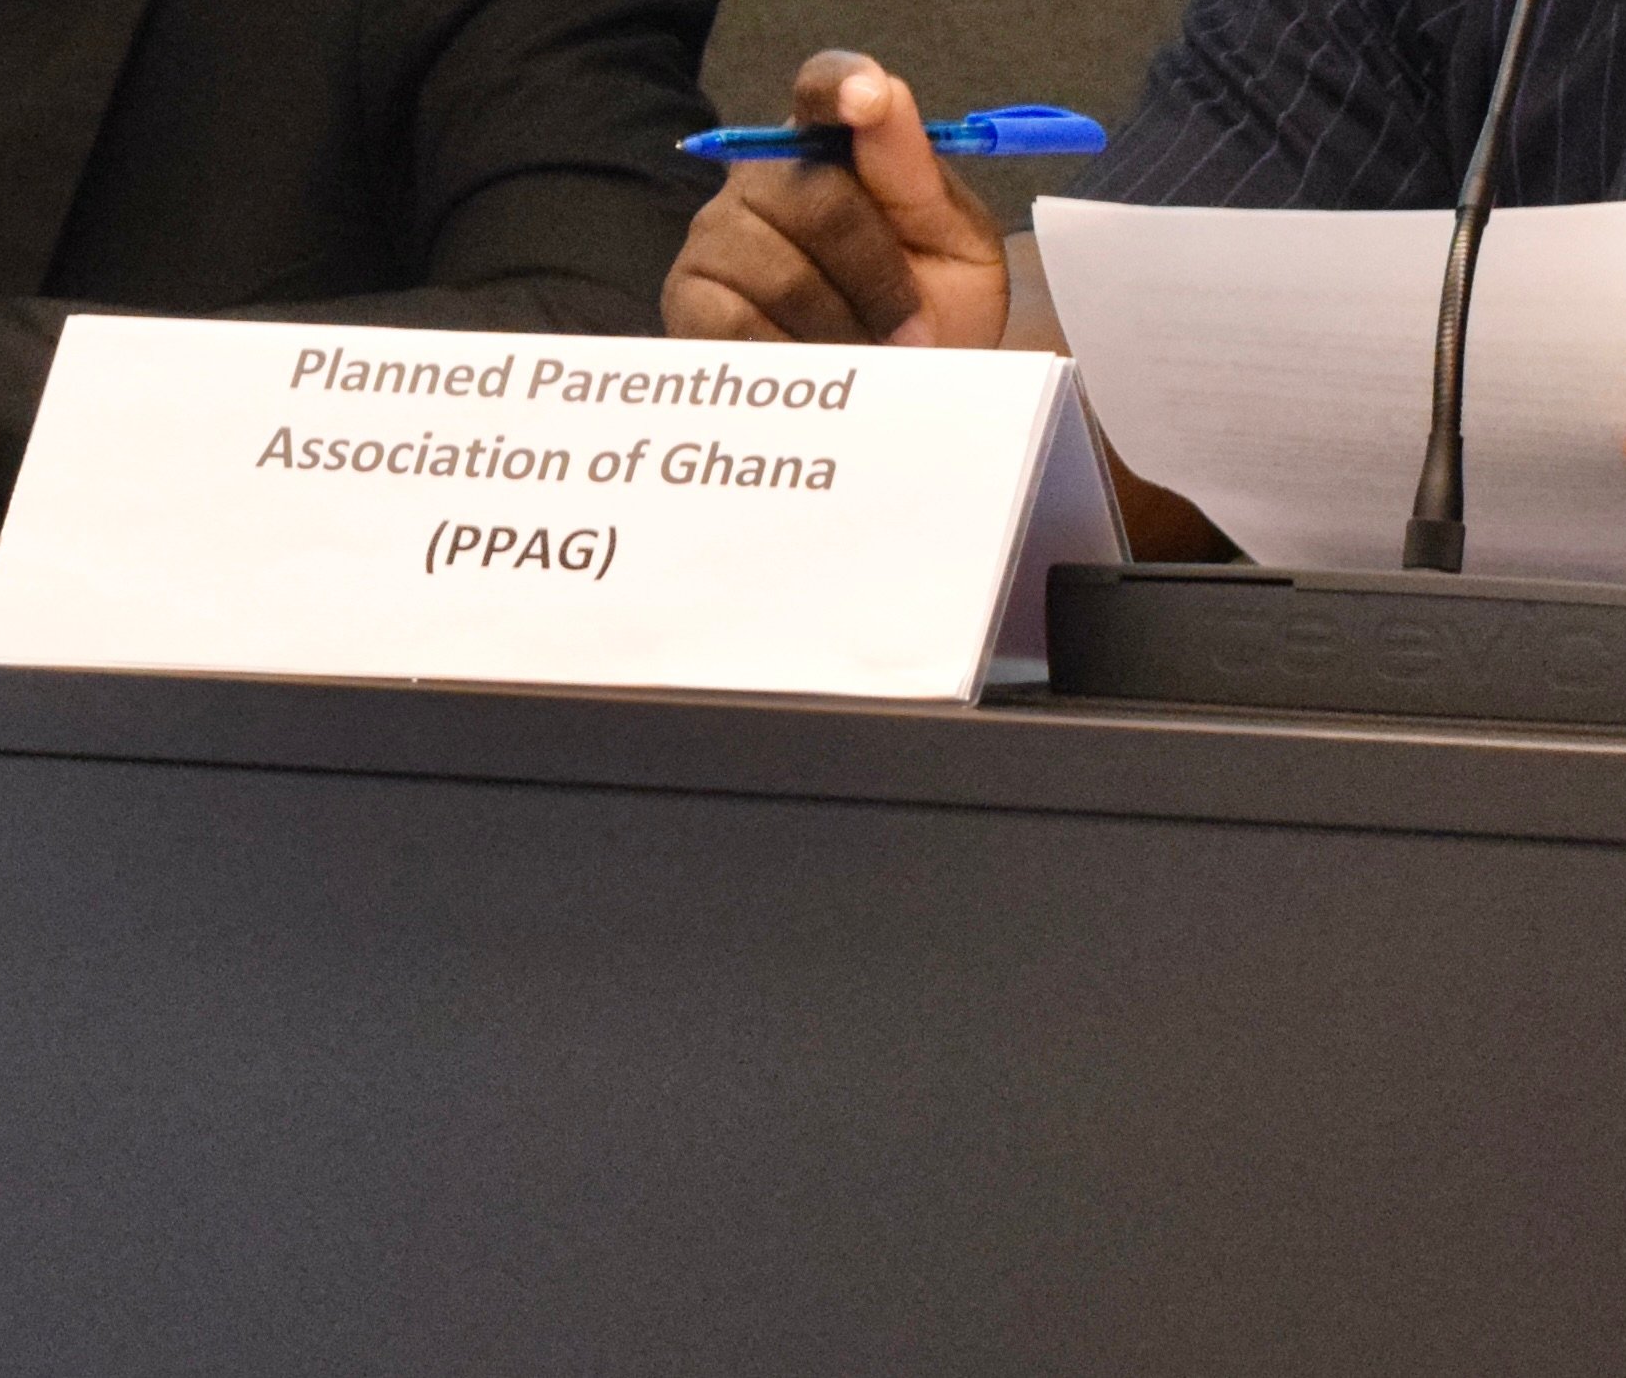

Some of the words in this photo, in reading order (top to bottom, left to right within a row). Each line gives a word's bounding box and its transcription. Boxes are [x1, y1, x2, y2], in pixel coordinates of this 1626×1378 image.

[290, 349, 515, 398] Planned
[527, 359, 857, 410] Parenthood
[256, 427, 571, 482] Association
[588, 439, 651, 483] of
[660, 442, 837, 490] Ghana
[425, 520, 618, 581] (PPAG)
